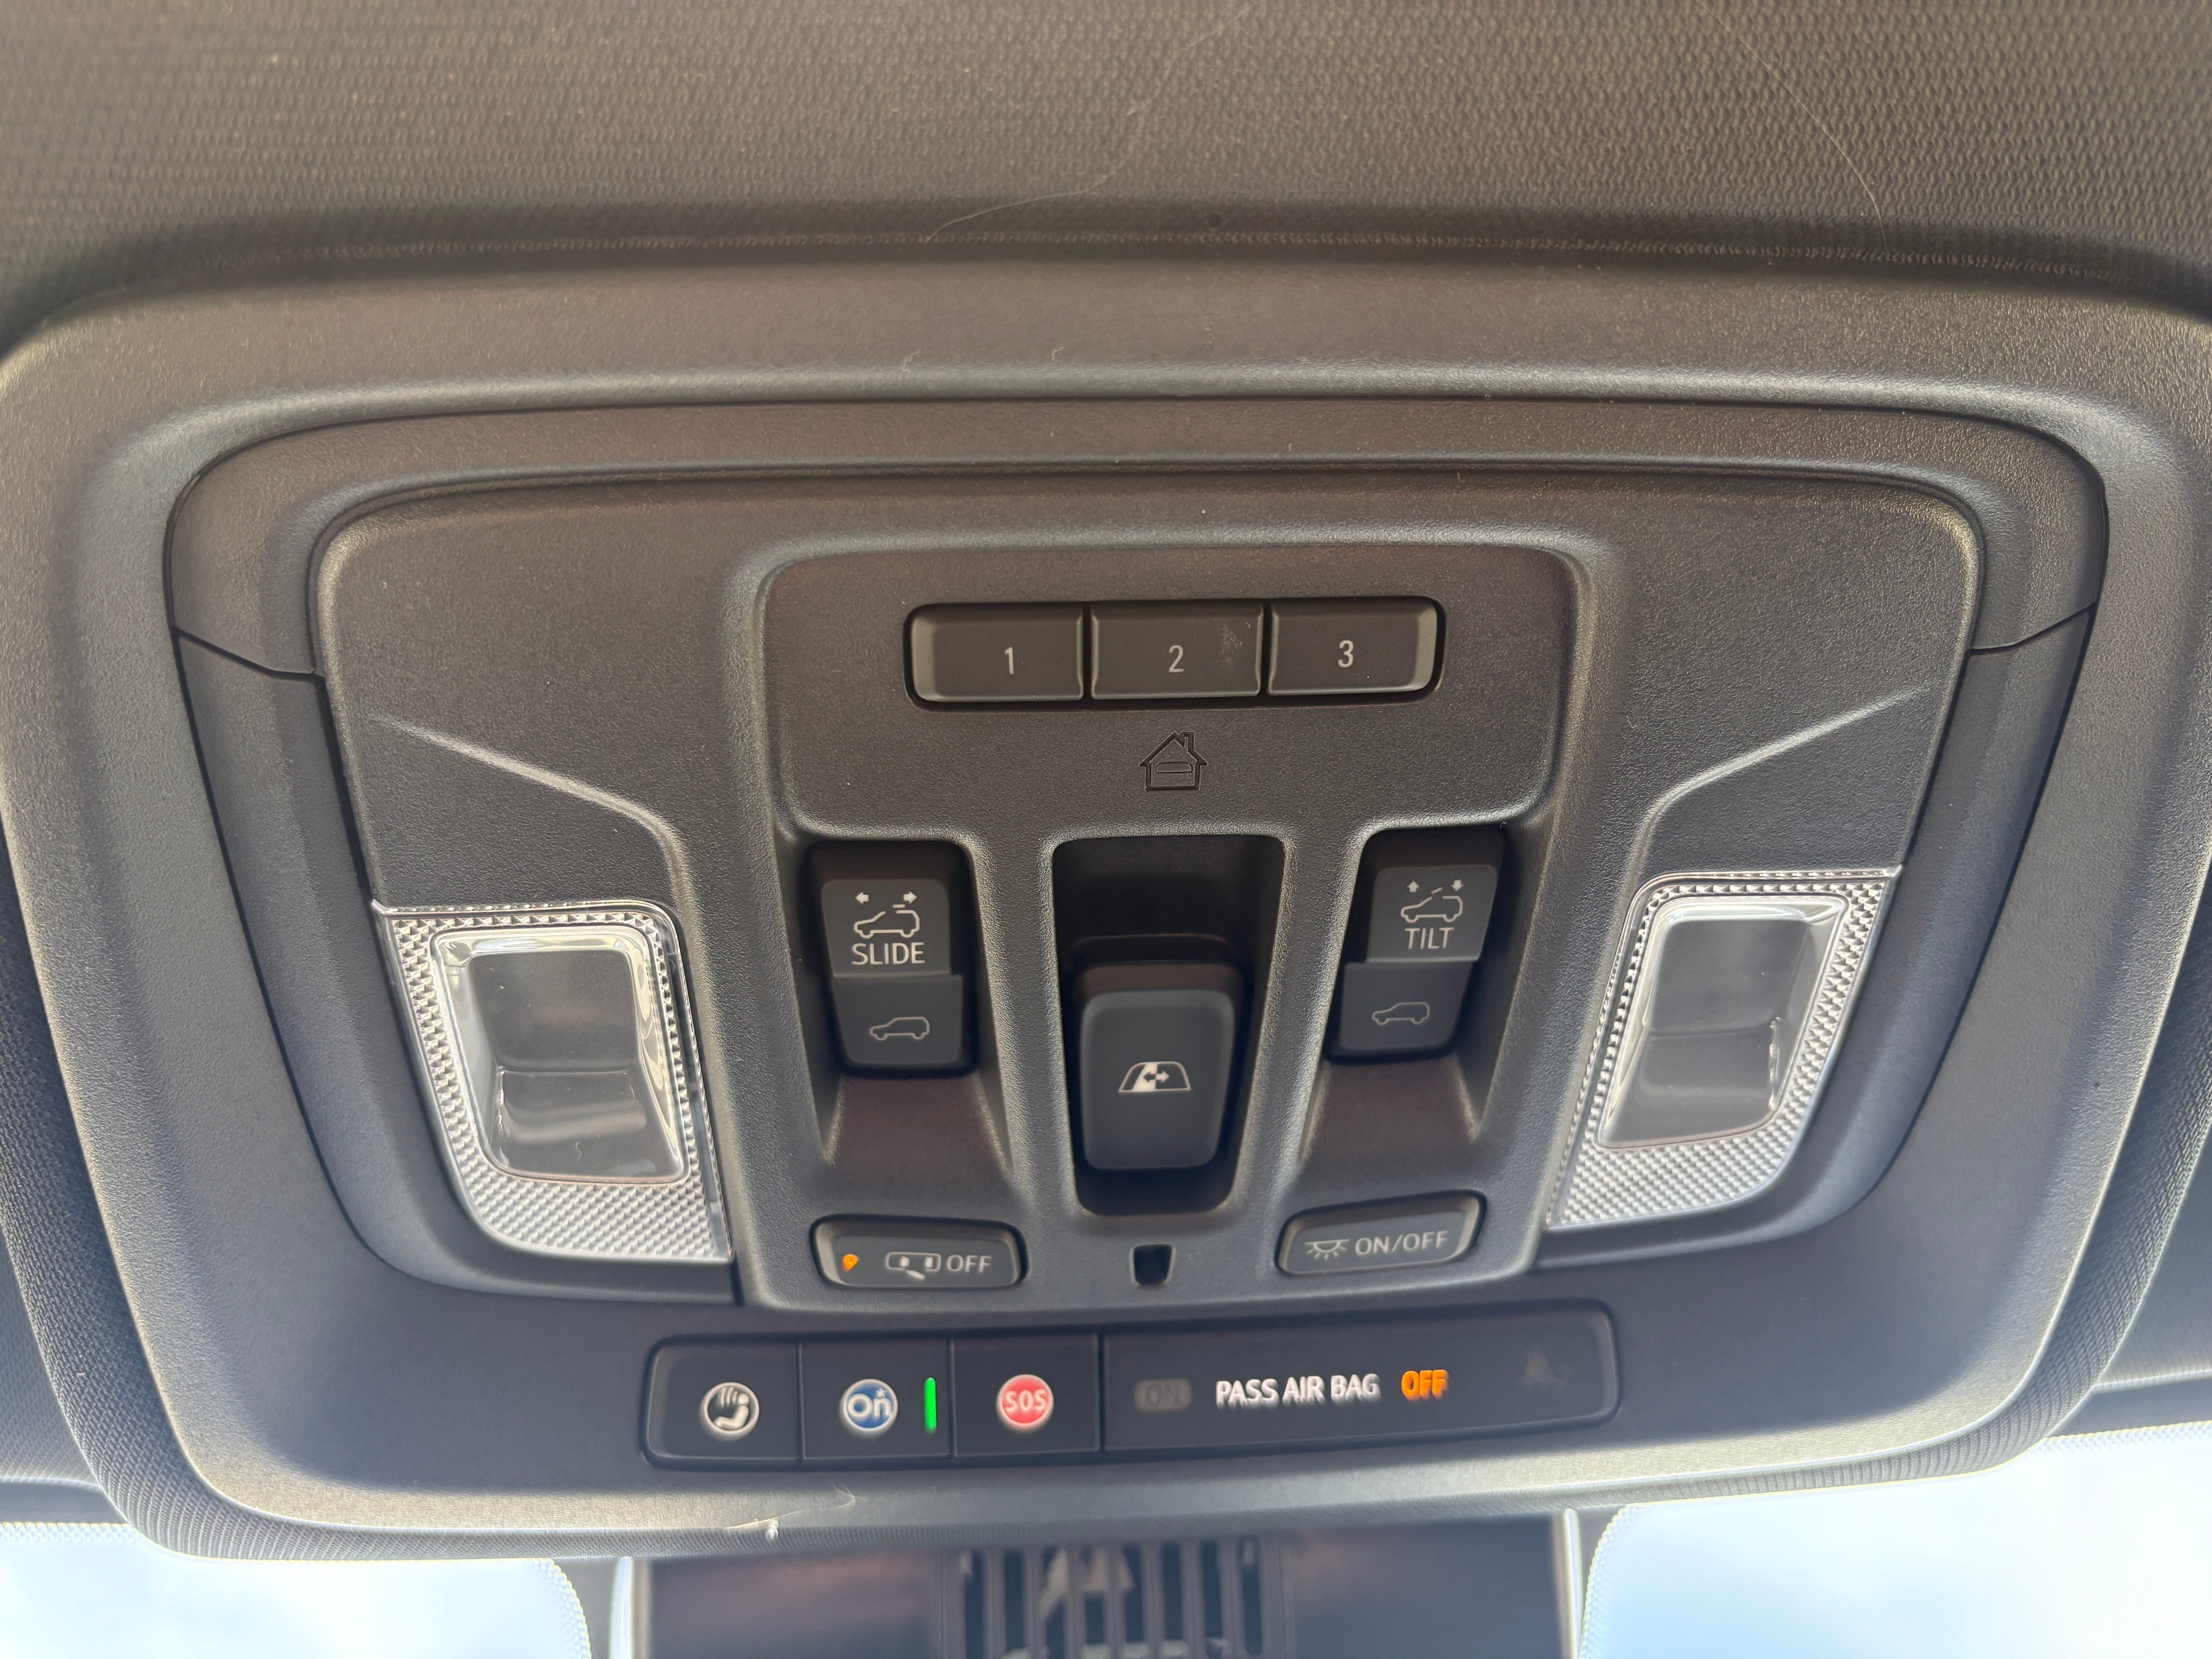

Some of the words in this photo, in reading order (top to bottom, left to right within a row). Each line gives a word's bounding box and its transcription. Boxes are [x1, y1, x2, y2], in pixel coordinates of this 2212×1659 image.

[1004, 647, 1014, 675] 1
[1168, 645, 1184, 673] 2
[1338, 640, 1354, 668] 3
[1405, 927, 1454, 949] TILT
[852, 942, 925, 965] SLIDE
[1355, 1230, 1448, 1255] ON/OFF
[946, 1255, 992, 1273] OFF
[1005, 1389, 1046, 1412] SOS
[1145, 1383, 1183, 1404] ON
[1216, 1379, 1278, 1407] PASS
[1283, 1376, 1324, 1404] AIR
[1331, 1374, 1379, 1401] BAG
[1401, 1370, 1449, 1399] OFF
